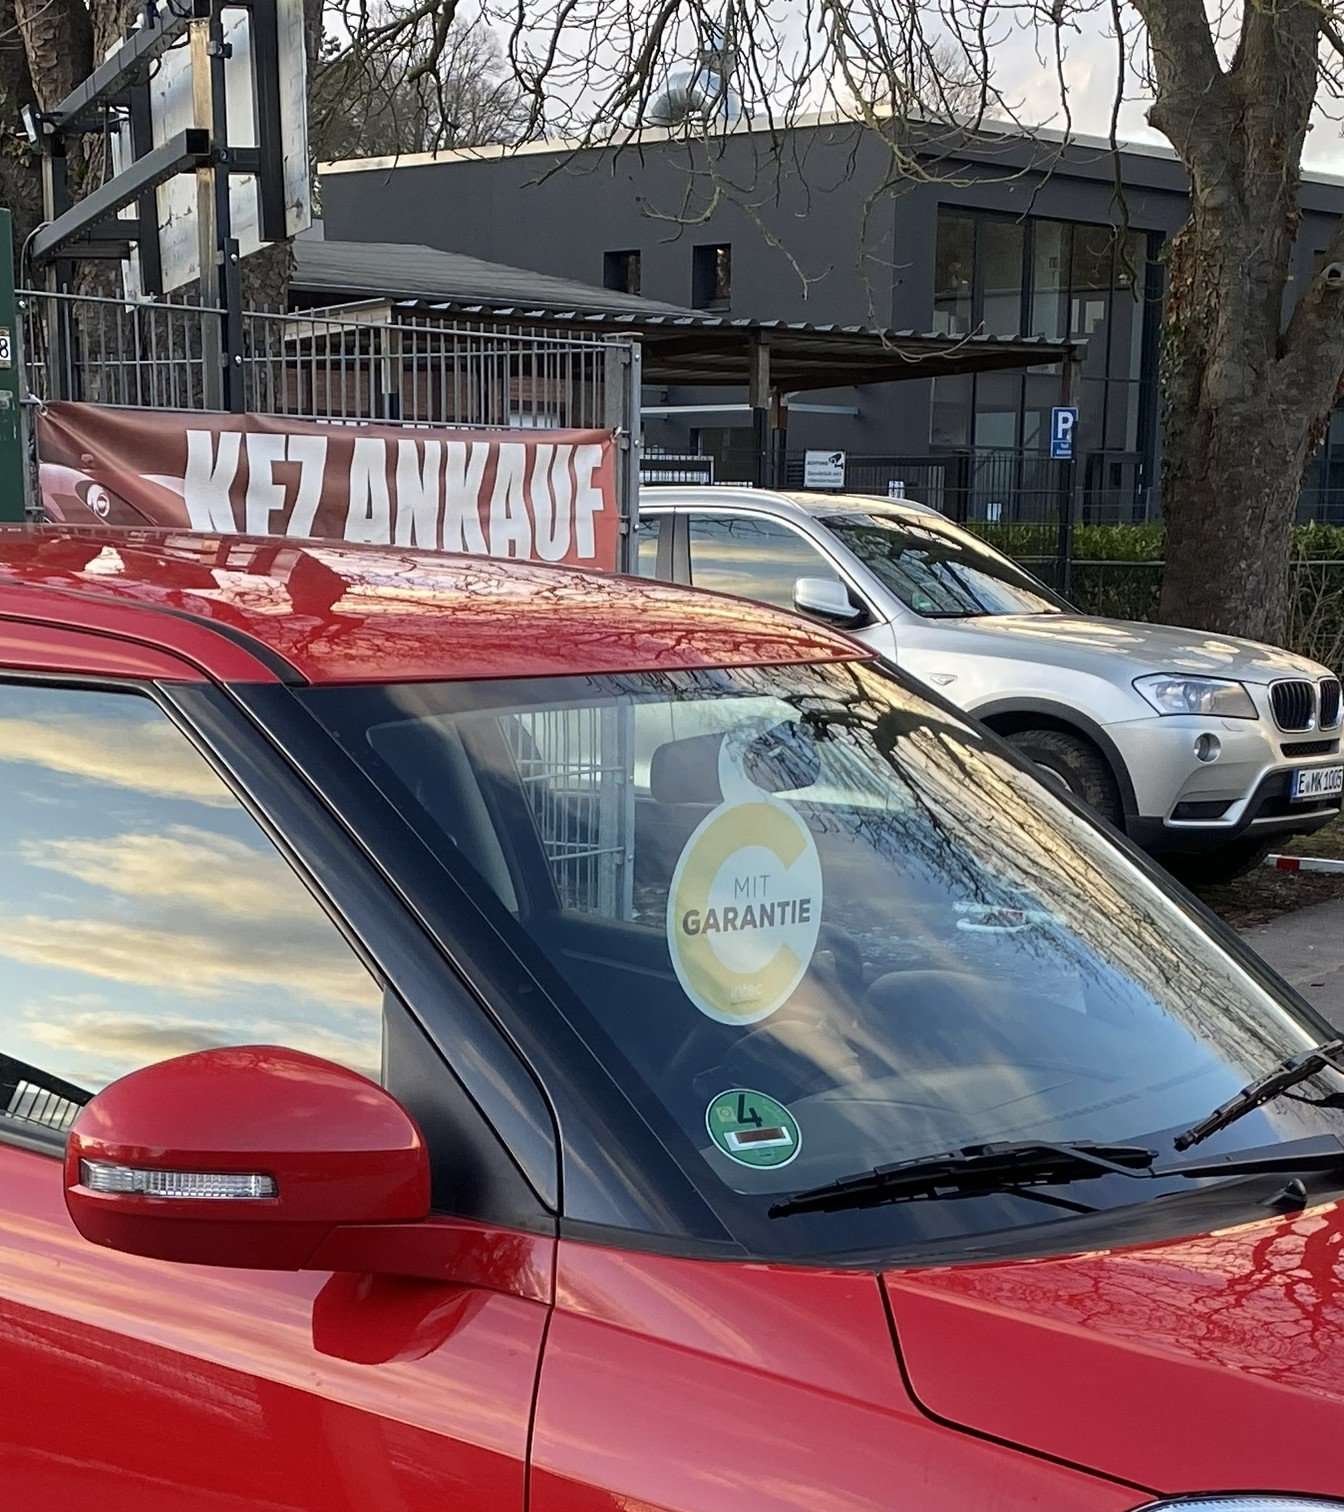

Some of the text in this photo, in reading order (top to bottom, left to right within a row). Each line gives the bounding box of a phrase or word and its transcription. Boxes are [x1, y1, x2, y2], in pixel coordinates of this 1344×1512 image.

[185, 430, 604, 561] KFZ ANKAUF
[734, 874, 772, 900] MIT
[682, 898, 812, 937] GARANTIE
[737, 1093, 763, 1127] 4
